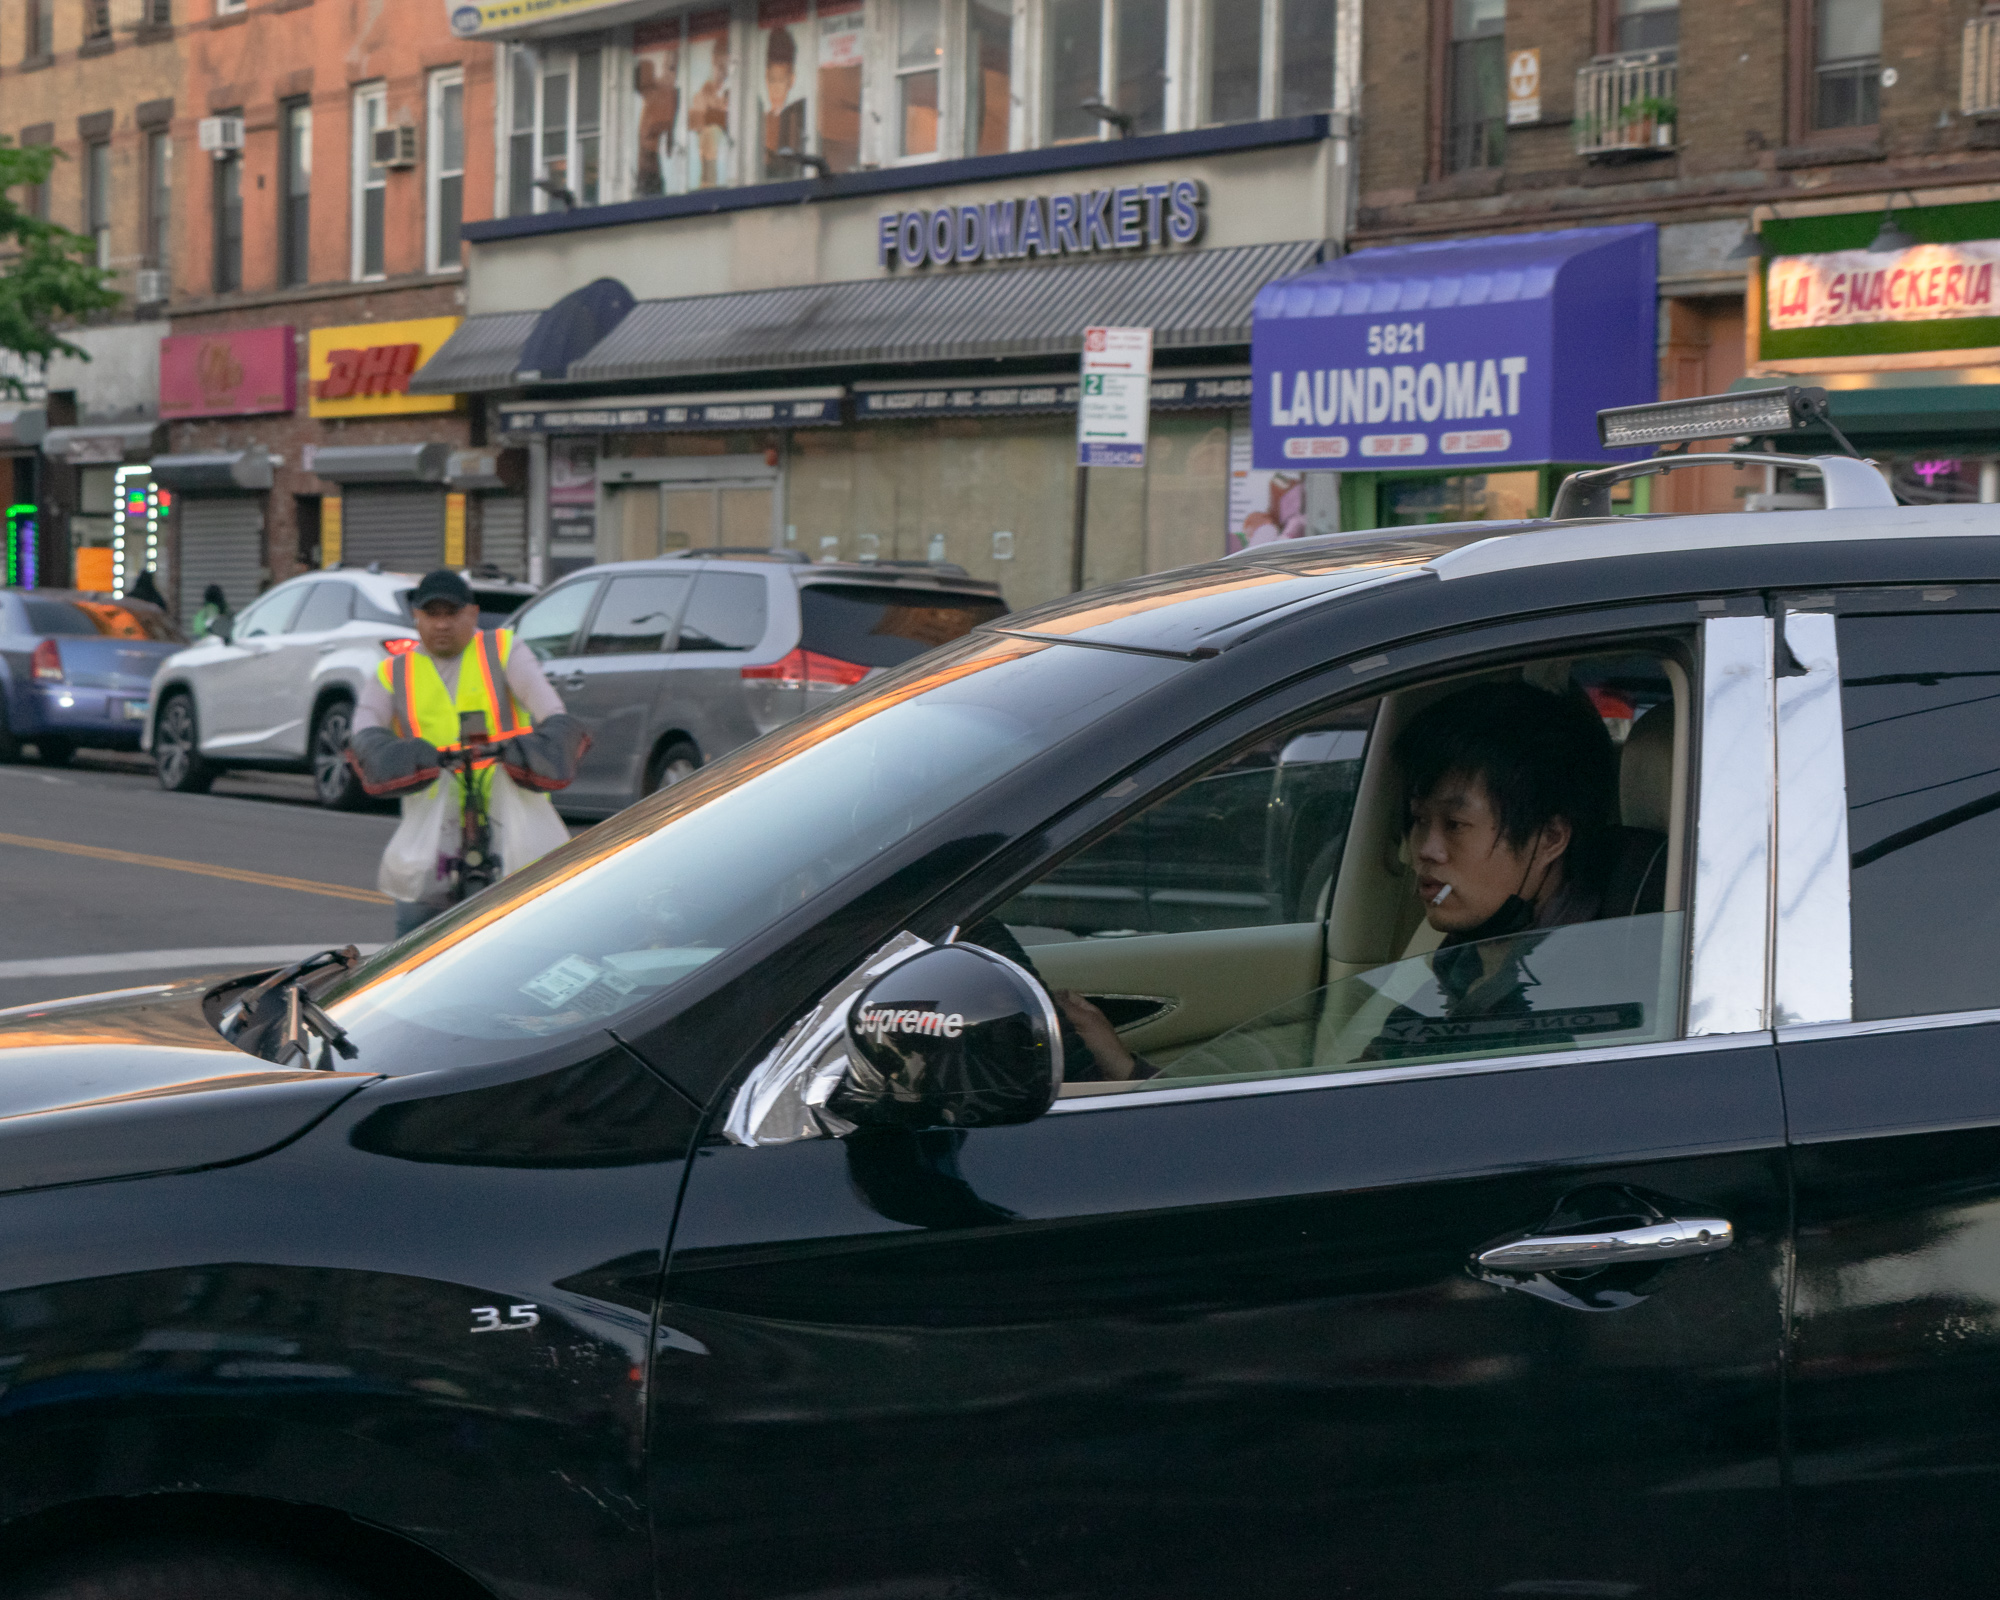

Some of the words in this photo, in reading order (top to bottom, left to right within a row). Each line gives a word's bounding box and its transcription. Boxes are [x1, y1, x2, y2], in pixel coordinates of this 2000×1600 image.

[879, 179, 1200, 268] FOODMARKETS
[1778, 276, 1811, 316] LA
[1828, 263, 1993, 314] SNACKERIA
[1367, 322, 1425, 355] 5821
[1087, 375, 1100, 395] 2
[1271, 356, 1527, 426] LAUNDROMAT
[855, 1000, 964, 1044] Supreme
